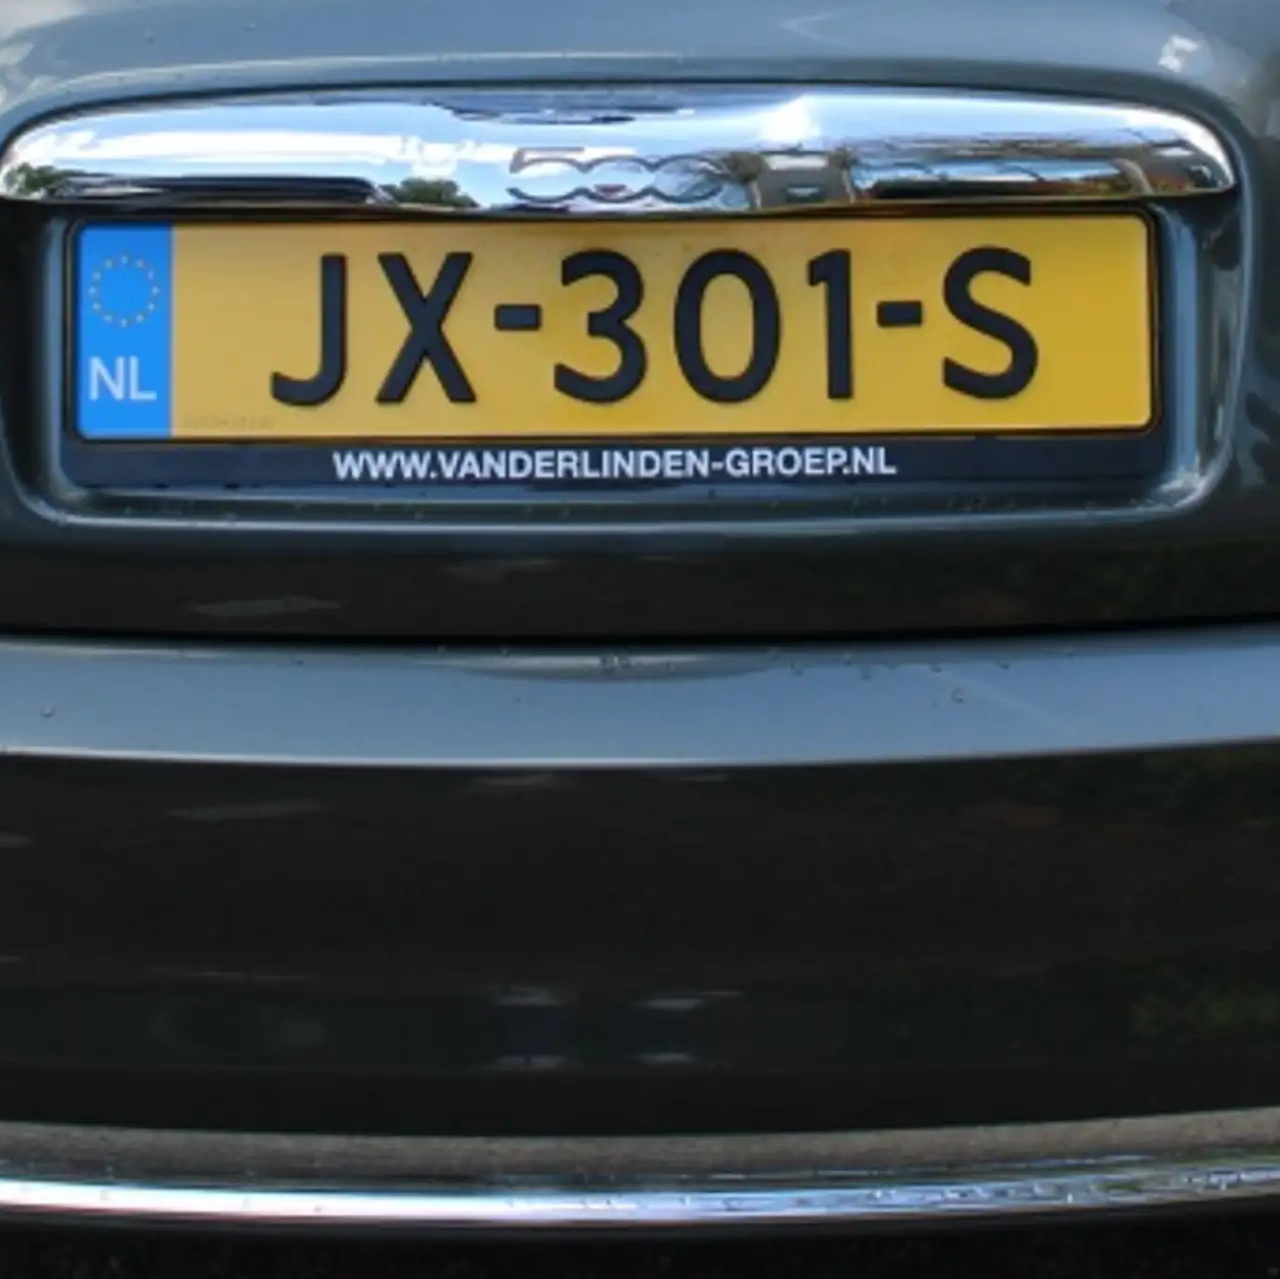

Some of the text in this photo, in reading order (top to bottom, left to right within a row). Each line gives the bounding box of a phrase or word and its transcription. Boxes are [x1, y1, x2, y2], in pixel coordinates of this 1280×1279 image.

[271, 246, 1040, 406] JX-301-S
[89, 355, 157, 401] NL
[332, 447, 898, 479] WWW.VANDERLINDEN-GROEP.NL
